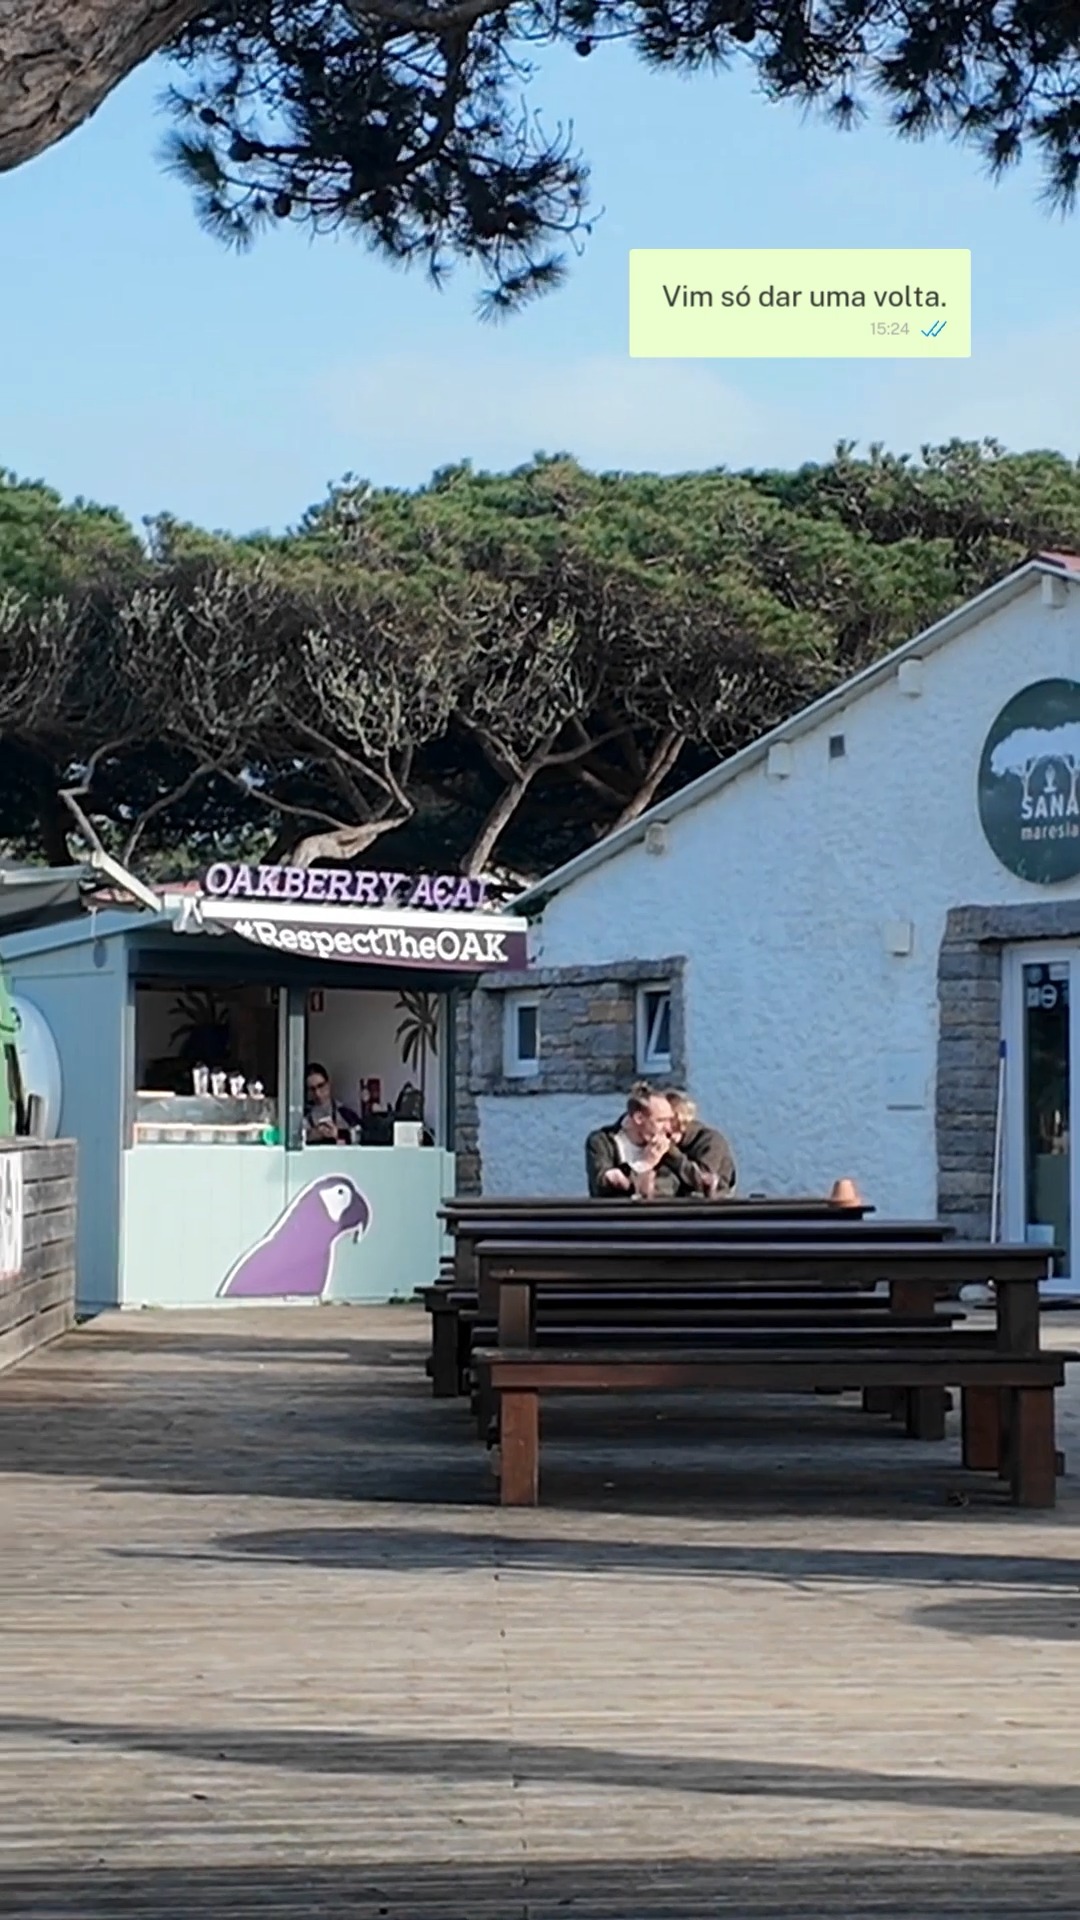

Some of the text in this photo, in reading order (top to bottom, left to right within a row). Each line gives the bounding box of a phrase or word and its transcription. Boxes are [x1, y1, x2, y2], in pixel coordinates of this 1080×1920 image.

[1021, 794, 1080, 819] SANA
[1021, 821, 1080, 840] maresia
[205, 862, 408, 903] OAKBERRY
[233, 919, 509, 963] #RespectTheOAK
